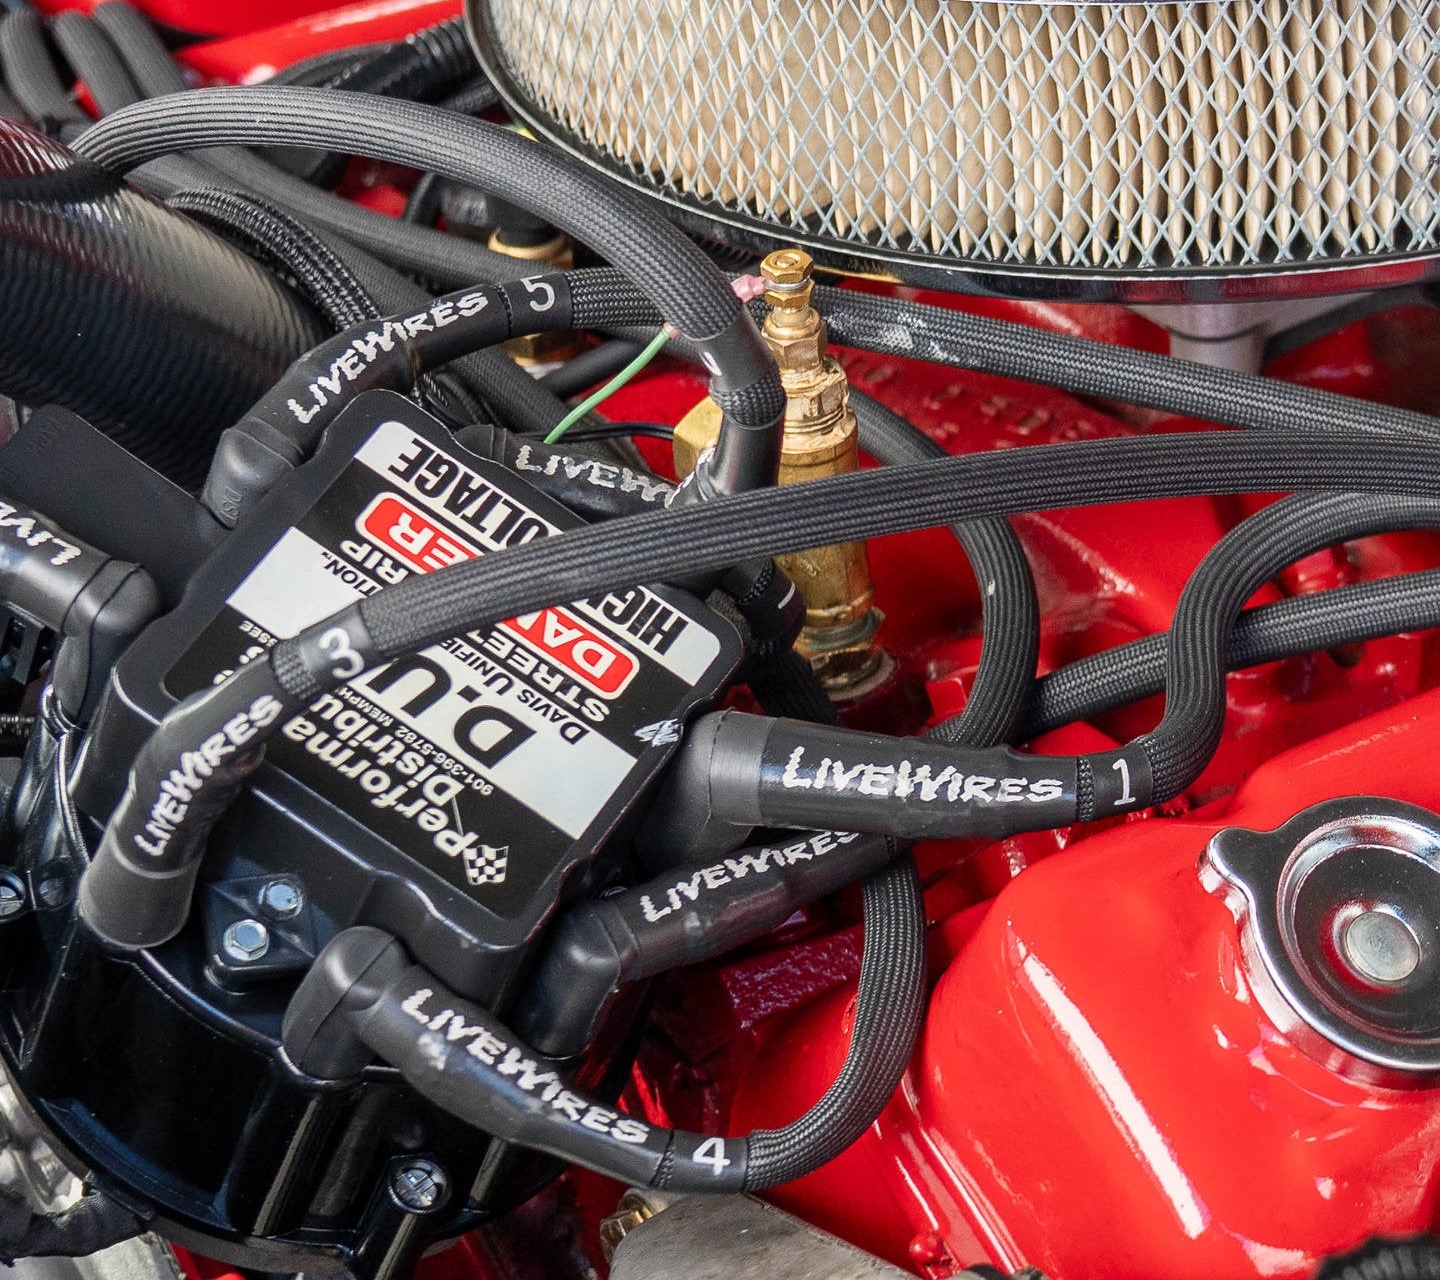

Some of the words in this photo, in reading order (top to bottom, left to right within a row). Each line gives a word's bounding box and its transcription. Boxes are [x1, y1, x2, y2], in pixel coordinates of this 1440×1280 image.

[287, 290, 490, 425] LIVEWIRES
[529, 275, 556, 311] 5
[387, 436, 544, 558] OLTAGE
[337, 531, 408, 588] RIP
[384, 509, 617, 680] DAER
[580, 582, 689, 657] HIG
[334, 684, 393, 728] MEMPH
[365, 639, 537, 779] D.U
[438, 637, 516, 698] UNIFIE
[135, 694, 280, 858] LIVEWIRES
[317, 626, 366, 680] 3
[393, 722, 494, 798] 901-396-5782
[782, 745, 1063, 803] LIVEWIRES
[1112, 758, 1137, 806] 1
[640, 828, 860, 923] LIVEWIRES
[400, 987, 649, 1144] LIVEWIRES
[691, 1137, 730, 1175] 4
